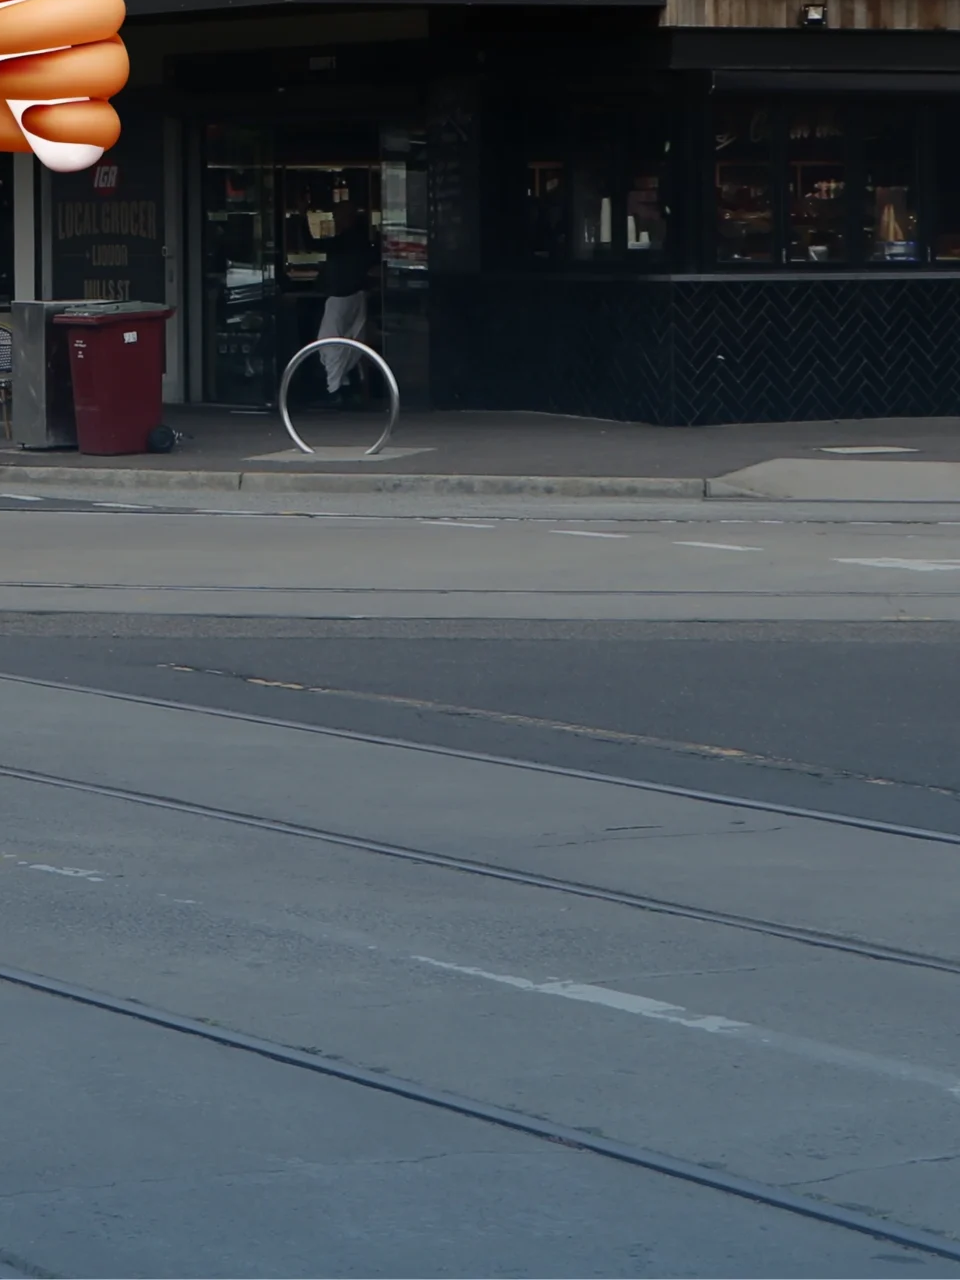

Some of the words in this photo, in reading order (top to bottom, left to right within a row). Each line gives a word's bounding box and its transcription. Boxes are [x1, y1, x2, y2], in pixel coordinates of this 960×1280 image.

[94, 166, 118, 188] IGA
[58, 201, 100, 240] LOCAL
[101, 200, 157, 240] GROCER
[92, 244, 128, 267] LIQUOR
